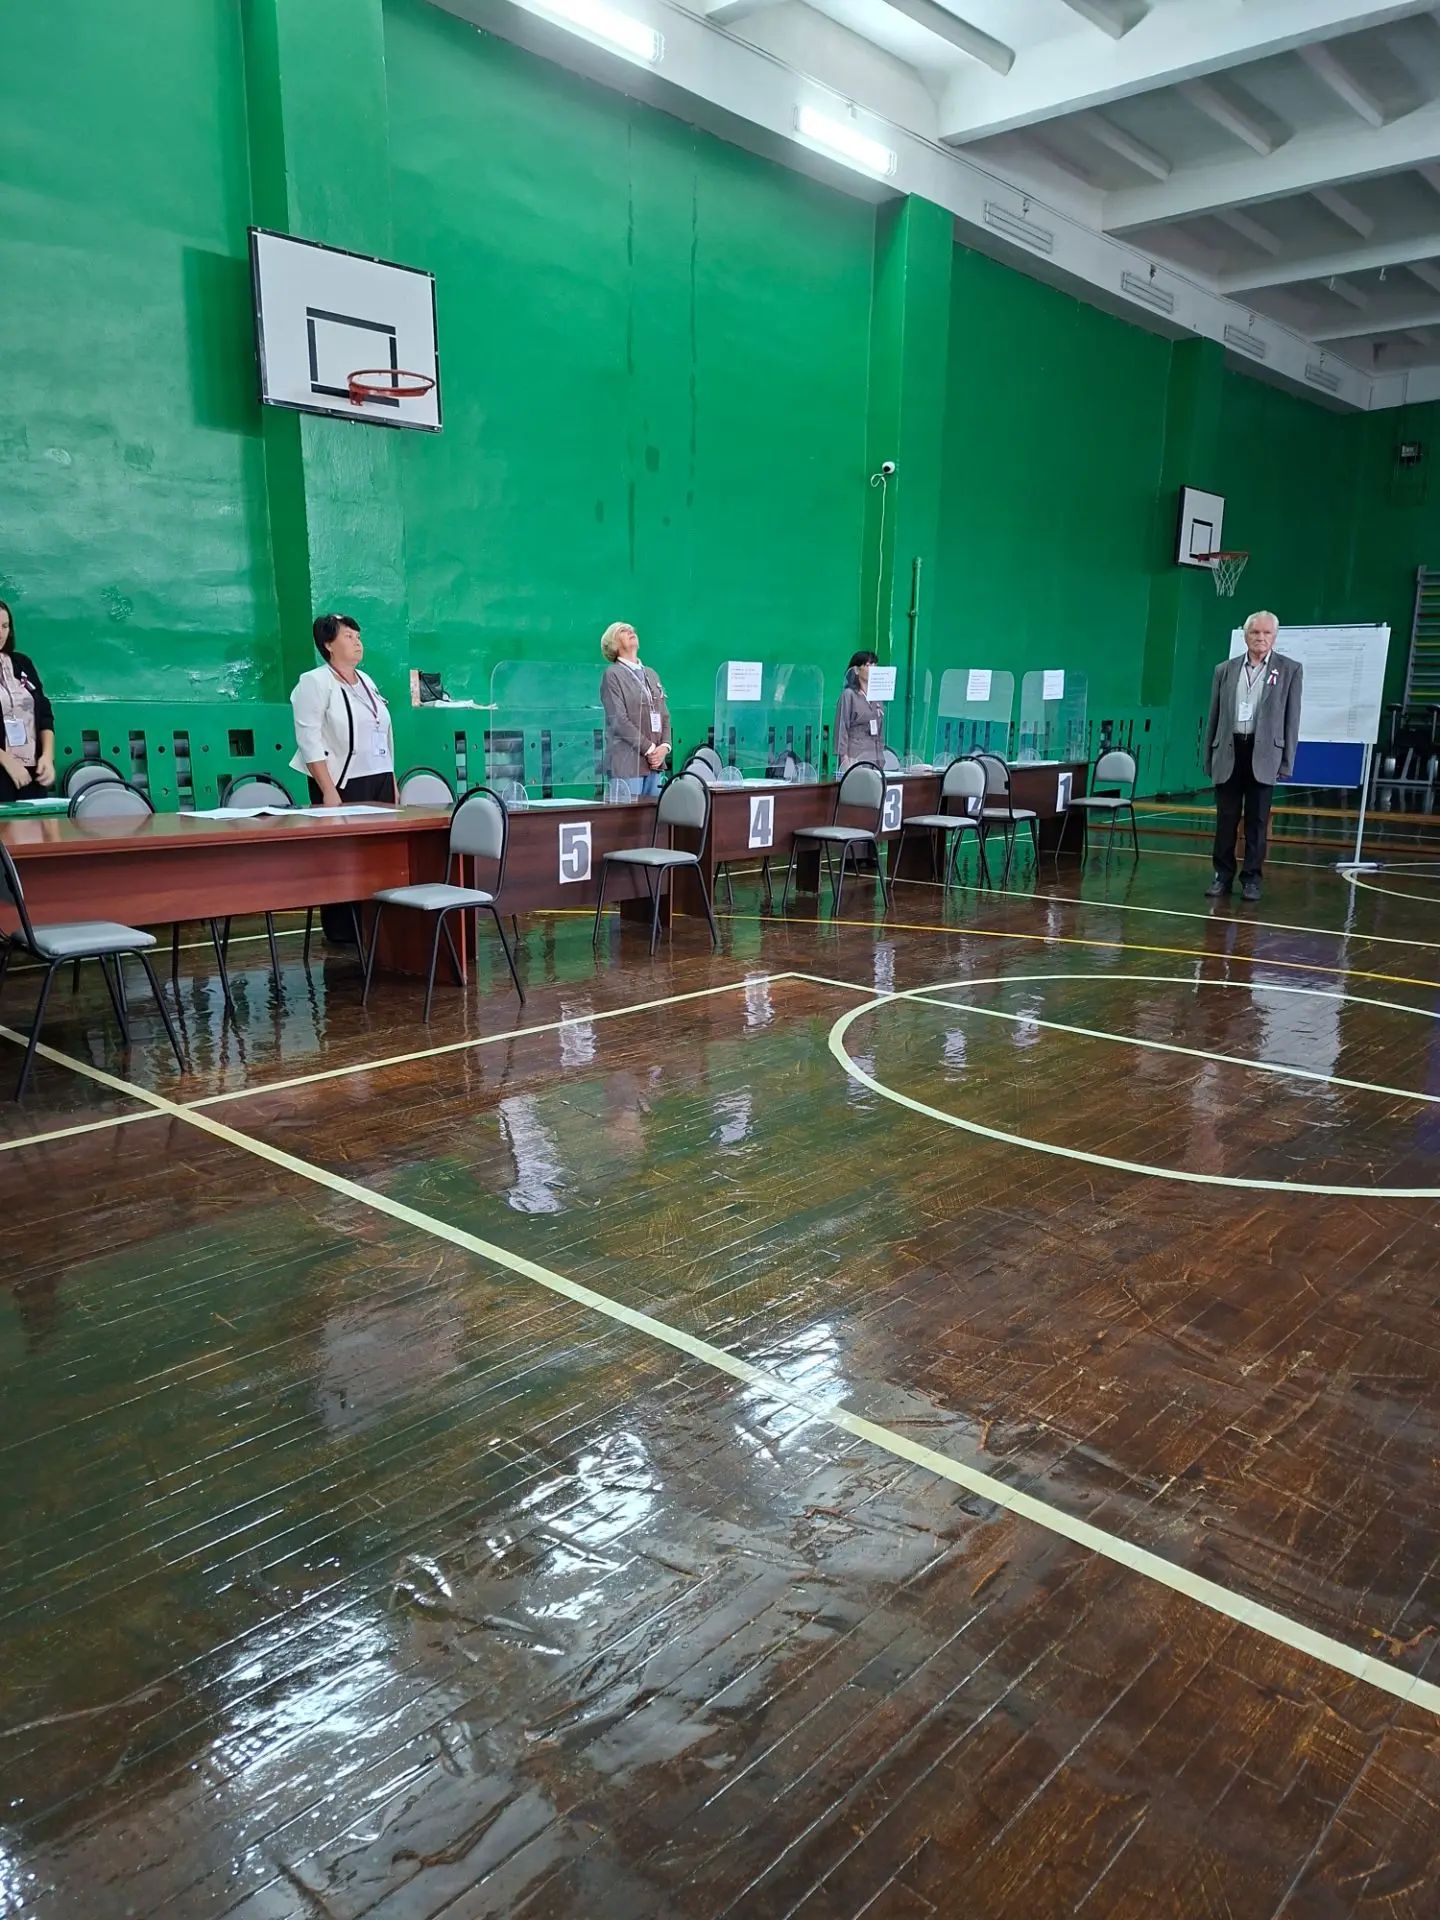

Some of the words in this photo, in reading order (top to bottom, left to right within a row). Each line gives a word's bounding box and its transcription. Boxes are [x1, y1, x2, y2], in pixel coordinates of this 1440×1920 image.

[885, 788, 901, 829] 3
[1060, 775, 1071, 809] 1
[751, 799, 772, 845] 4
[562, 827, 589, 879] 5
